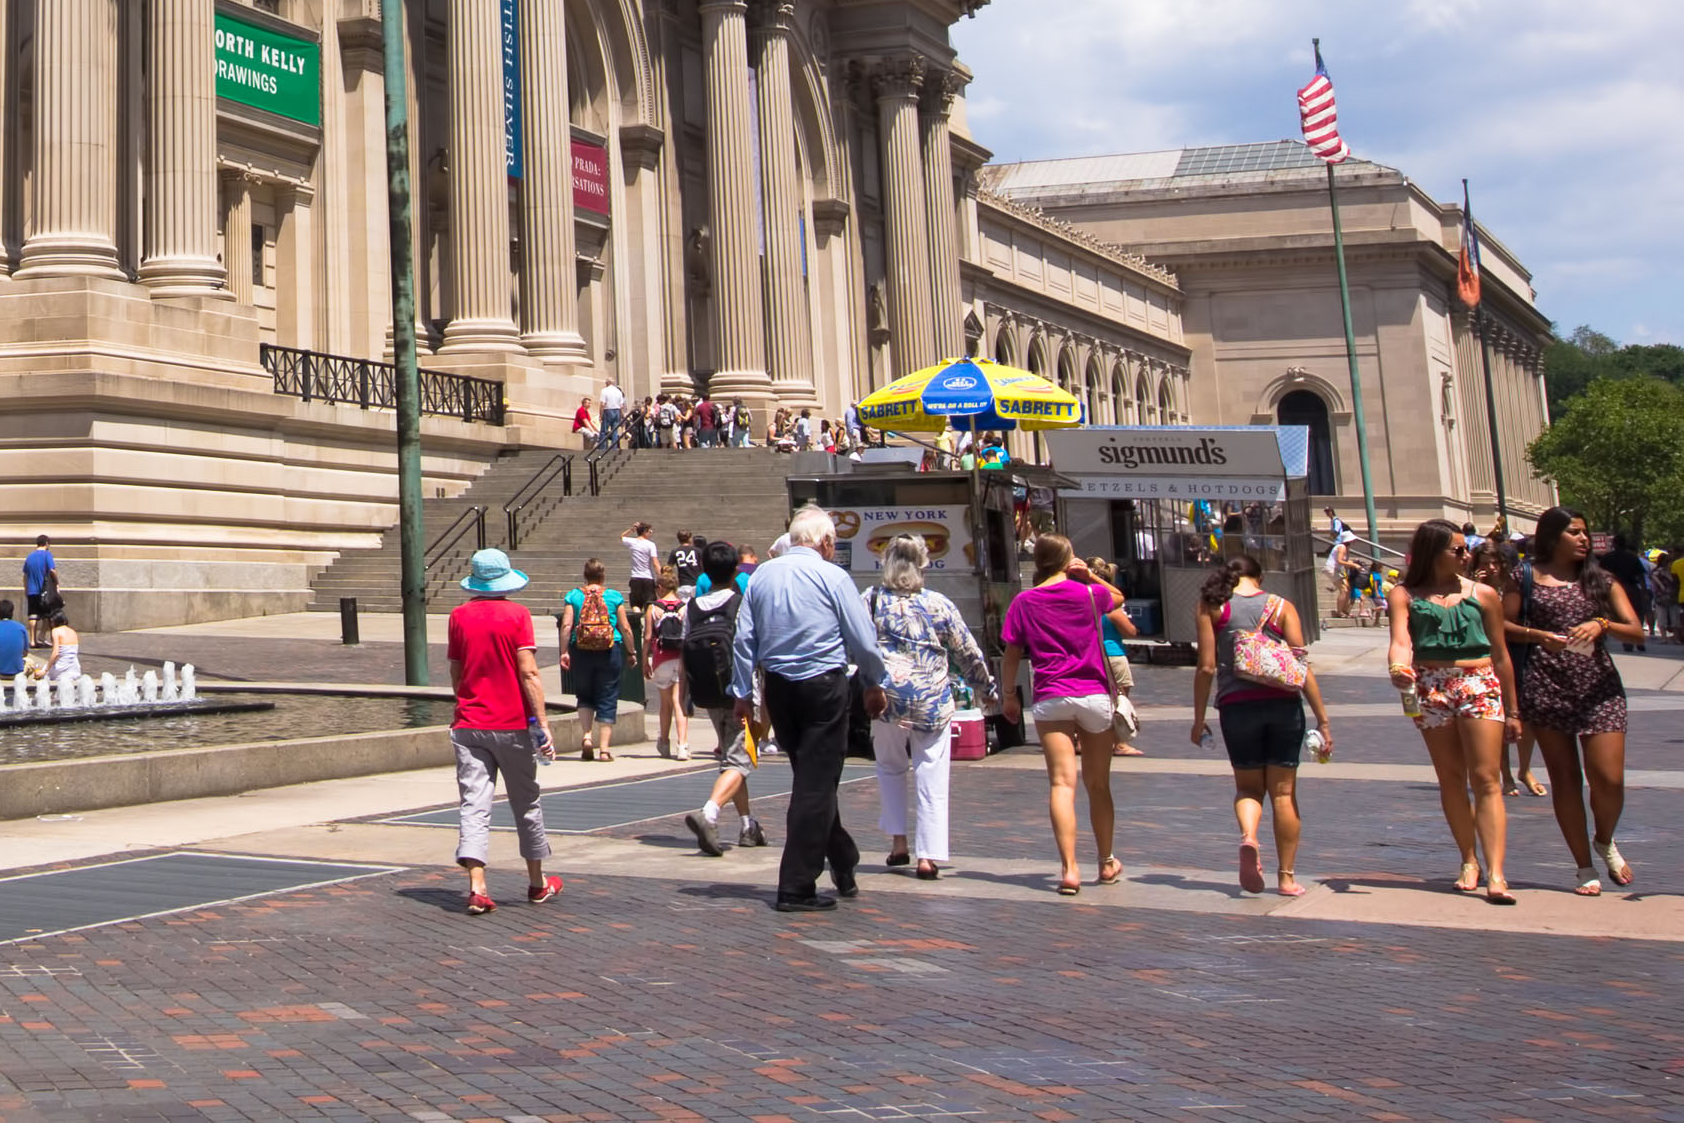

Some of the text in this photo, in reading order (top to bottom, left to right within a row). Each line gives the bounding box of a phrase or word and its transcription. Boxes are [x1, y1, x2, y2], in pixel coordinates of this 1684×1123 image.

[215, 29, 305, 75] ORTH KELLY
[505, 76, 515, 166] SILVER
[574, 156, 601, 176] PRADA:
[861, 399, 916, 420] SABRETT
[1000, 399, 1076, 416] SABRETT
[1098, 437, 1227, 469] sigmund's
[1087, 482, 1277, 494] ETZELS & HOTDOGS
[864, 509, 947, 521] NEW YORK
[676, 550, 698, 567] 24
